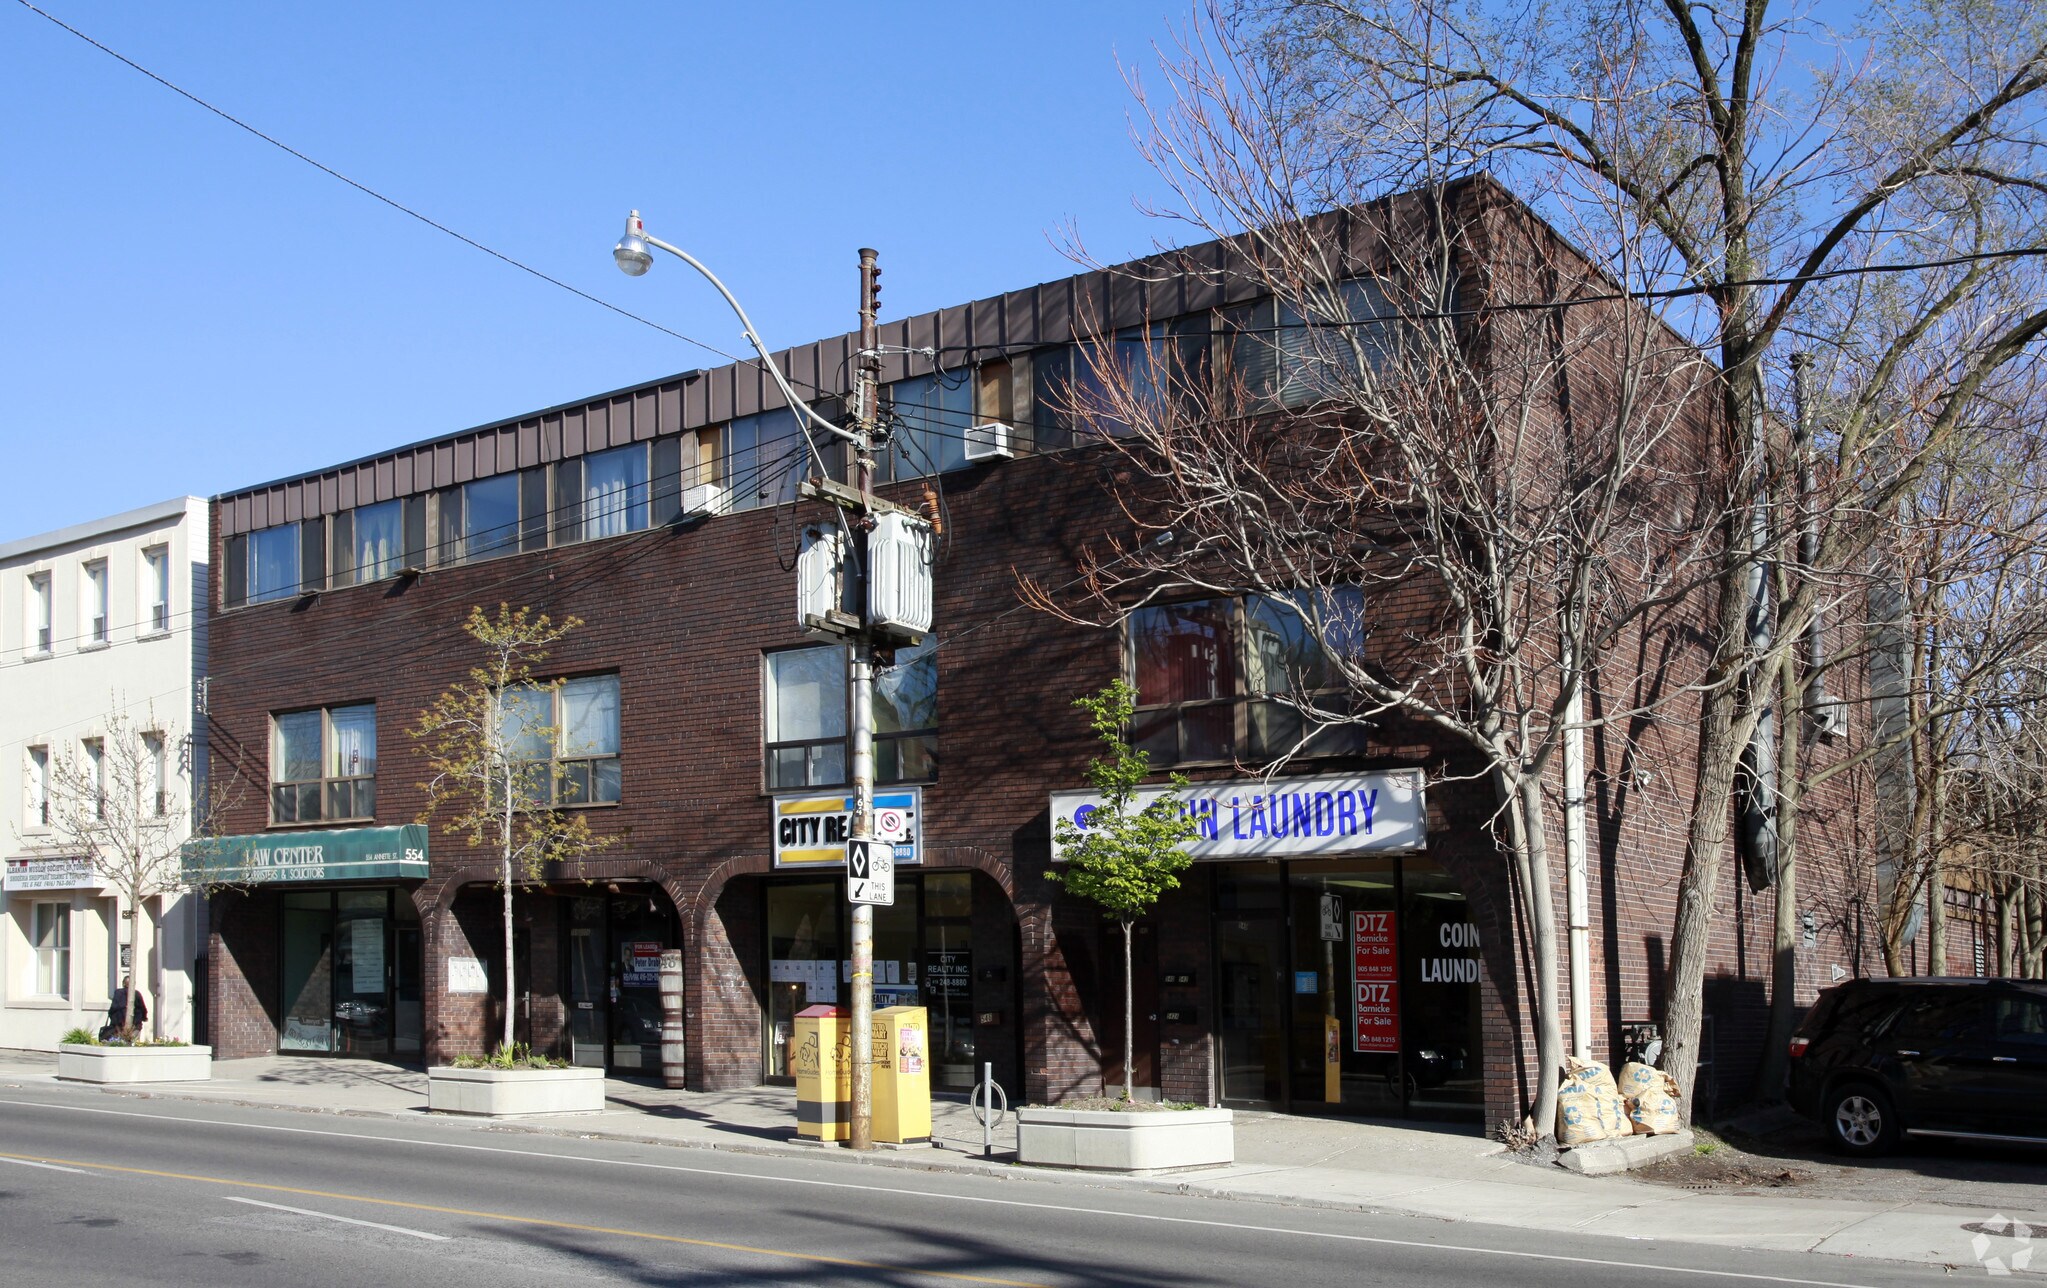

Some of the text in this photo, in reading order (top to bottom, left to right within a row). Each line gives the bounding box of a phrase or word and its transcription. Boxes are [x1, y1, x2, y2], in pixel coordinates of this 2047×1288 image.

[1232, 789, 1378, 840] LAUNDRY
[780, 817, 821, 844] CITY
[274, 845, 324, 864] CENTER
[405, 849, 424, 861] 554
[893, 848, 911, 857] -8880
[281, 870, 287, 879] &
[289, 867, 325, 879] SOLICITORS
[871, 882, 886, 891] THIS
[869, 893, 887, 901] LANE
[1355, 914, 1388, 932] DTZ
[1356, 934, 1388, 942] Barnicke
[1440, 923, 1480, 947] COIN
[1356, 946, 1390, 955] For Sale
[940, 955, 956, 963] CITY
[927, 965, 970, 973] REALTY INC.
[1357, 984, 1391, 1002] DTZ
[1358, 1004, 1390, 1013] Barnicke
[1358, 1016, 1392, 1025] For Sale
